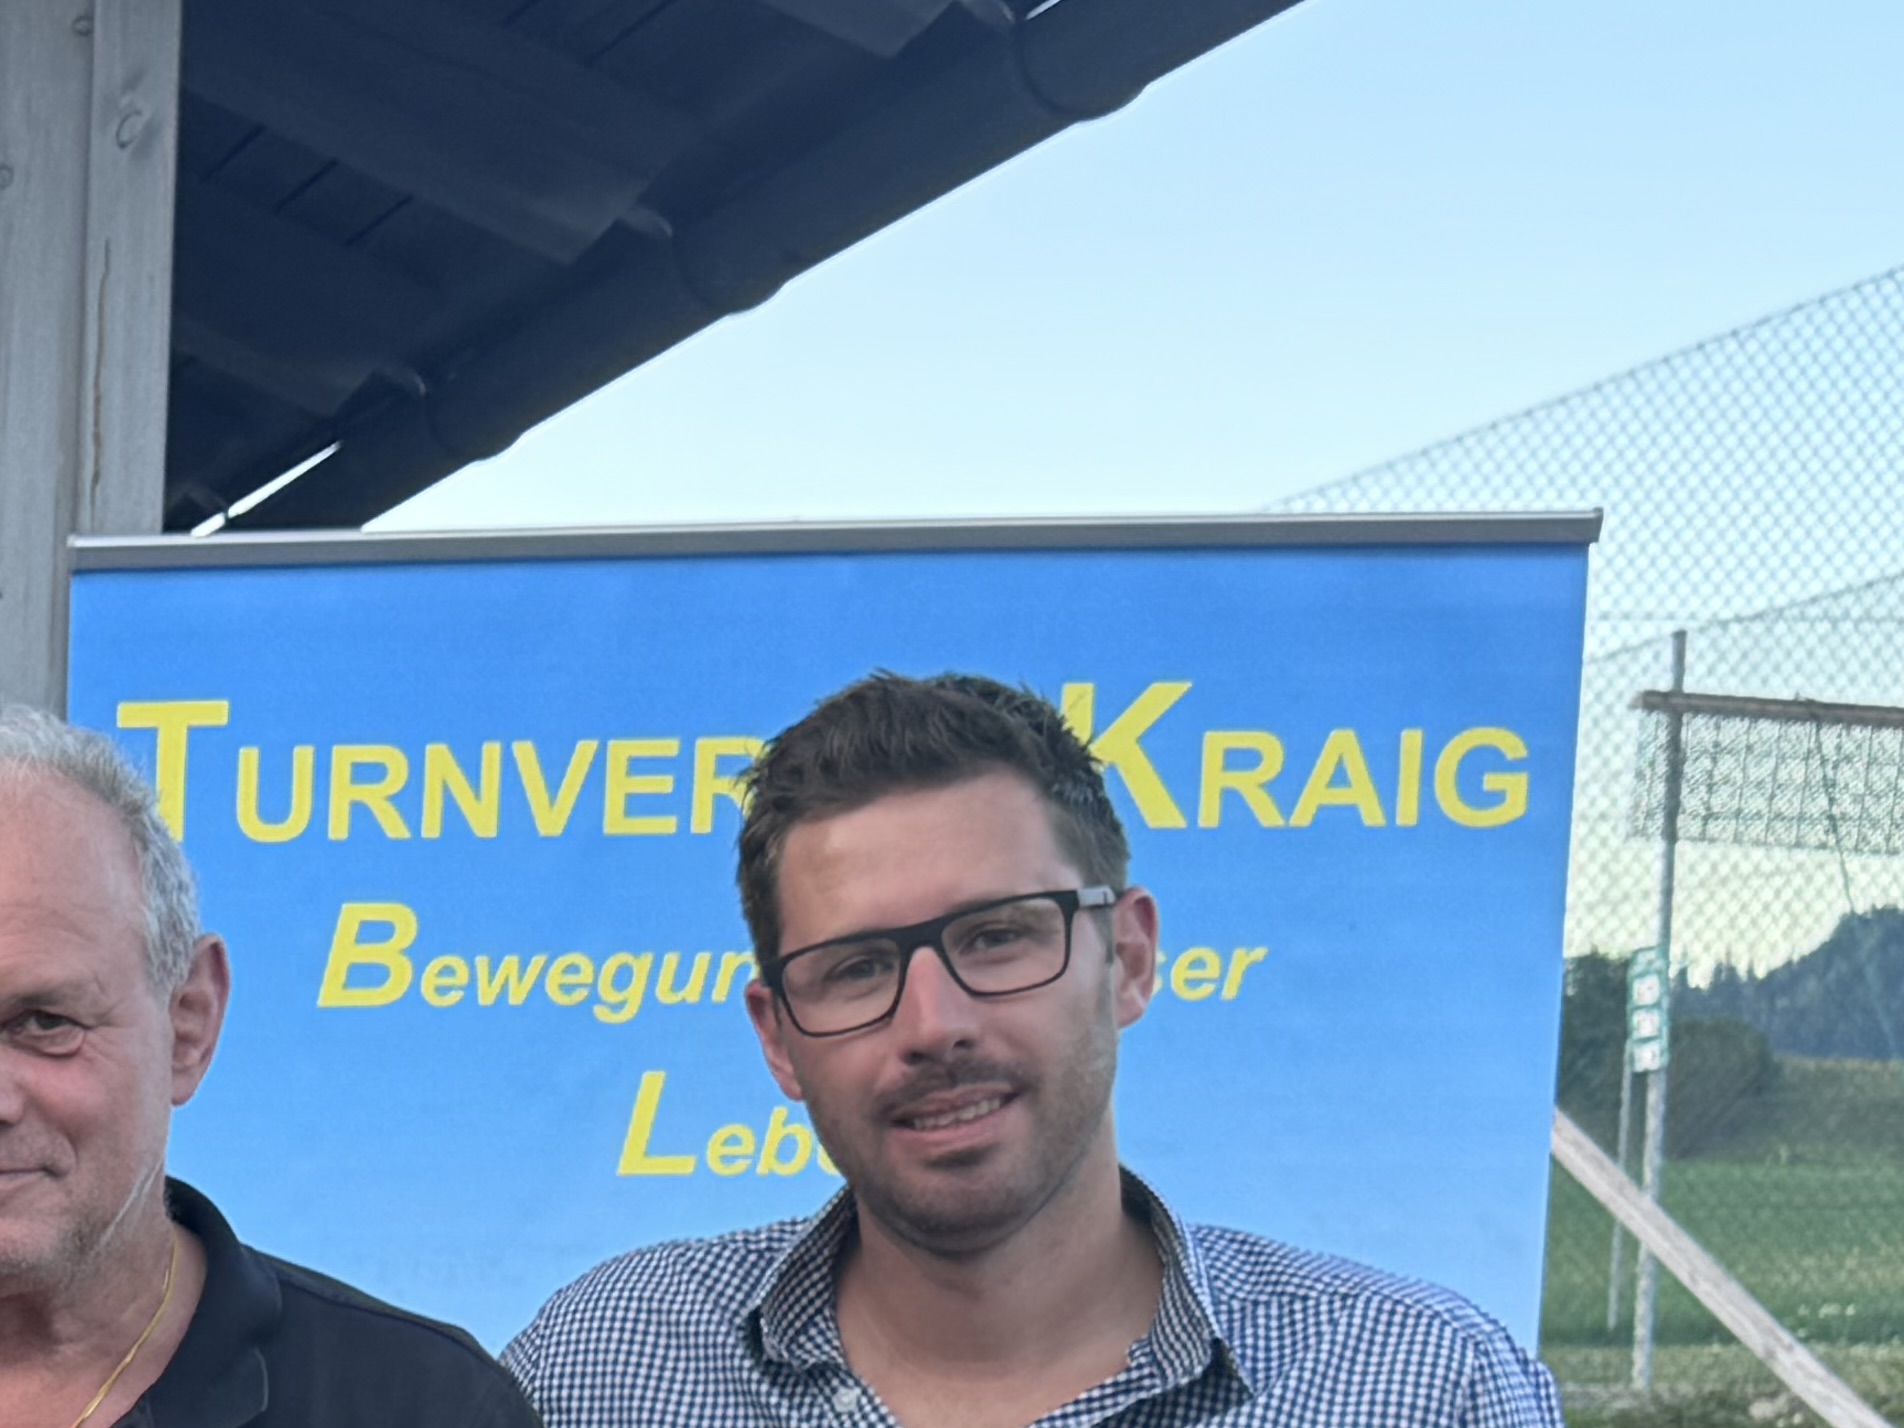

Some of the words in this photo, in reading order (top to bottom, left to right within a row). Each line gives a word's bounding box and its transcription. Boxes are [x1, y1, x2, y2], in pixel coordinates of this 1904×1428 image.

[117, 699, 768, 843] TURNVER
[1059, 680, 1529, 829] KRAIG
[316, 902, 761, 1024] Bewegun
[616, 1070, 842, 1177] Leb
